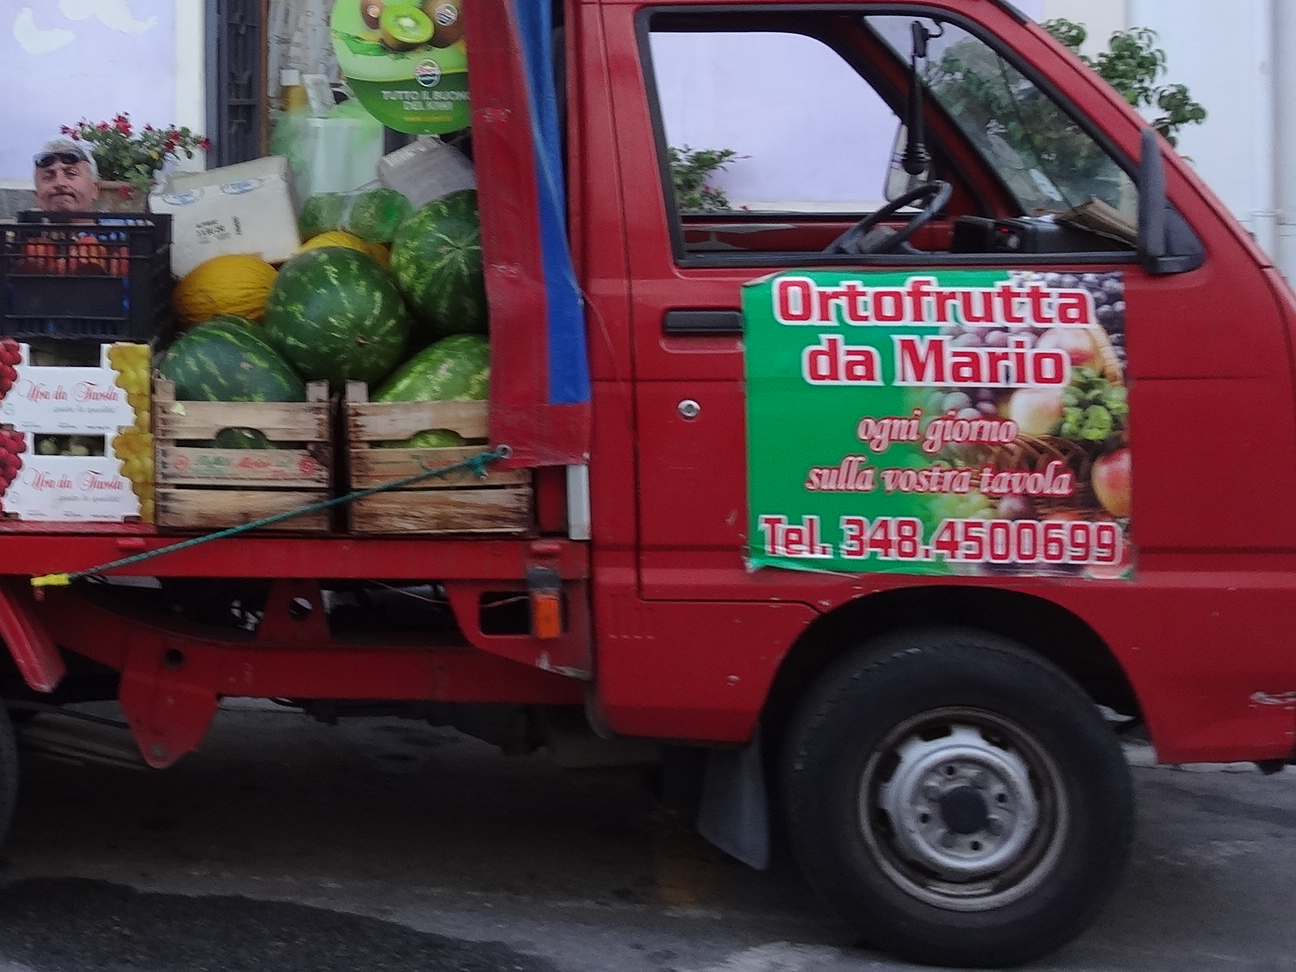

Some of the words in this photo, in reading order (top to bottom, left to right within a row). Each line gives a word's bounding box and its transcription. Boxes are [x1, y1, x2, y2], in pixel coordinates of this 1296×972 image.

[774, 277, 1095, 326] Ortofrutta
[803, 335, 882, 385] da
[893, 334, 1070, 386] Mario
[857, 409, 921, 452] ogni
[921, 409, 1019, 453] giorno
[806, 456, 874, 492] sulla
[881, 463, 972, 494] vostra
[979, 460, 1074, 496] tavola
[760, 515, 833, 559] Tel.
[841, 516, 1124, 564] 348.4500699
